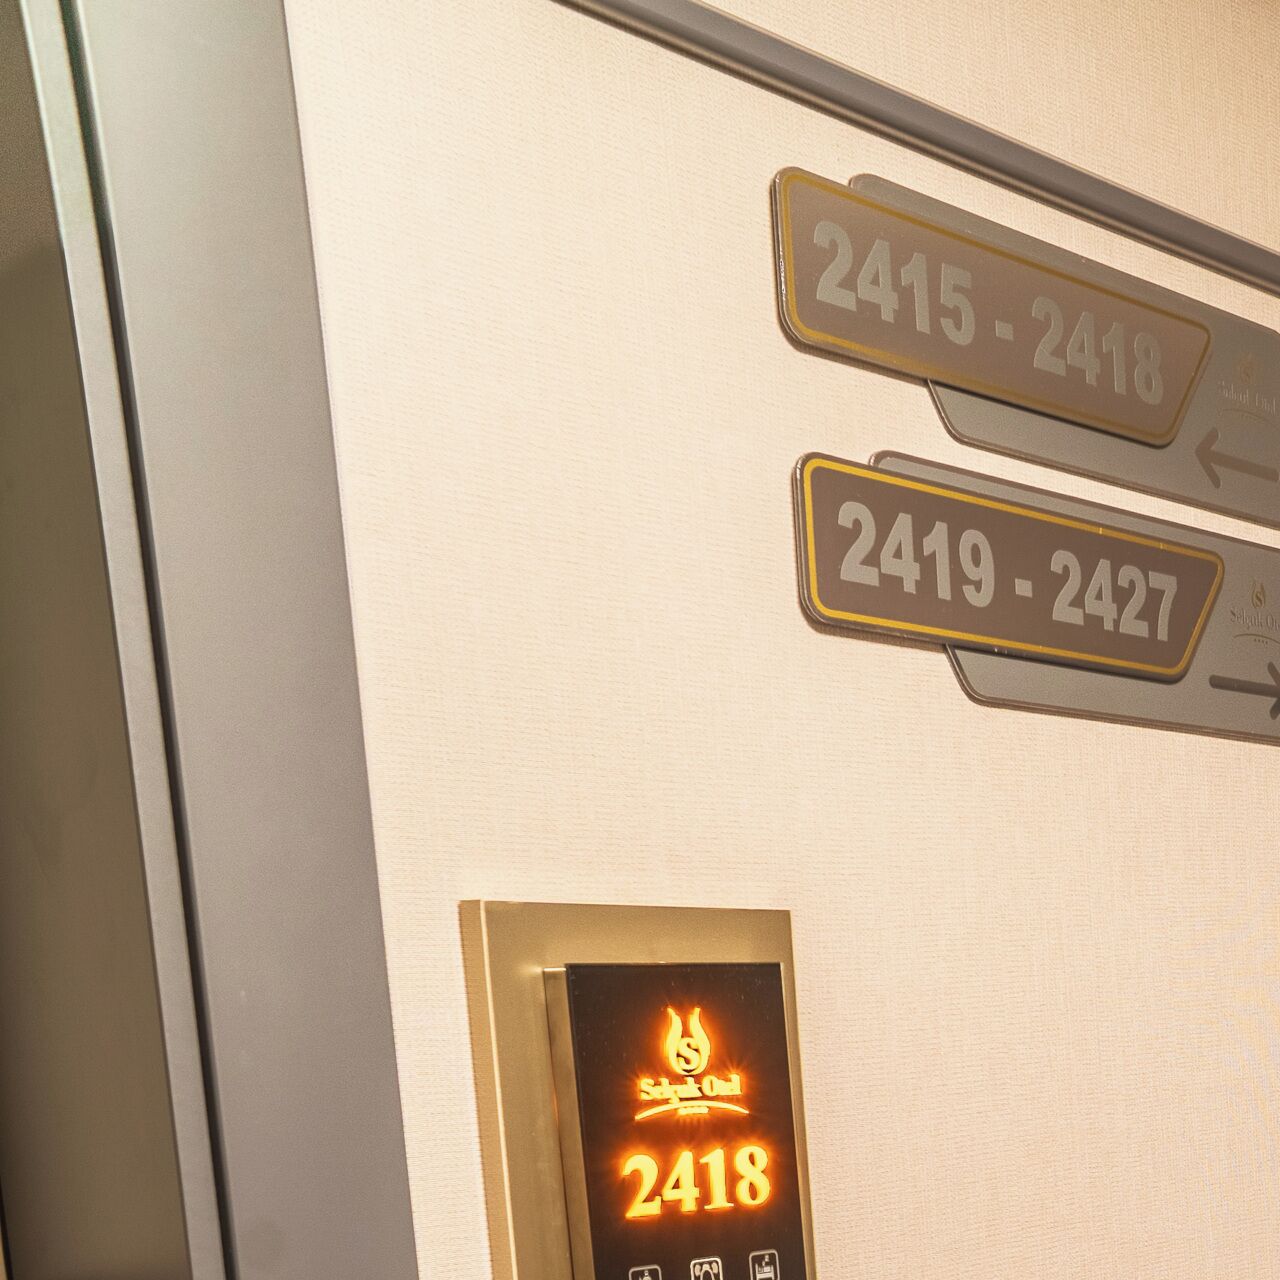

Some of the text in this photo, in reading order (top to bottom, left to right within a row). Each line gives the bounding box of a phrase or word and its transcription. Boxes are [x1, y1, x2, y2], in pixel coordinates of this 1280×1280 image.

[812, 221, 976, 346] 2415
[1031, 296, 1165, 406] 2418
[837, 500, 996, 609] 2419
[1050, 549, 1178, 642] 2427
[622, 1145, 771, 1219] 2418
